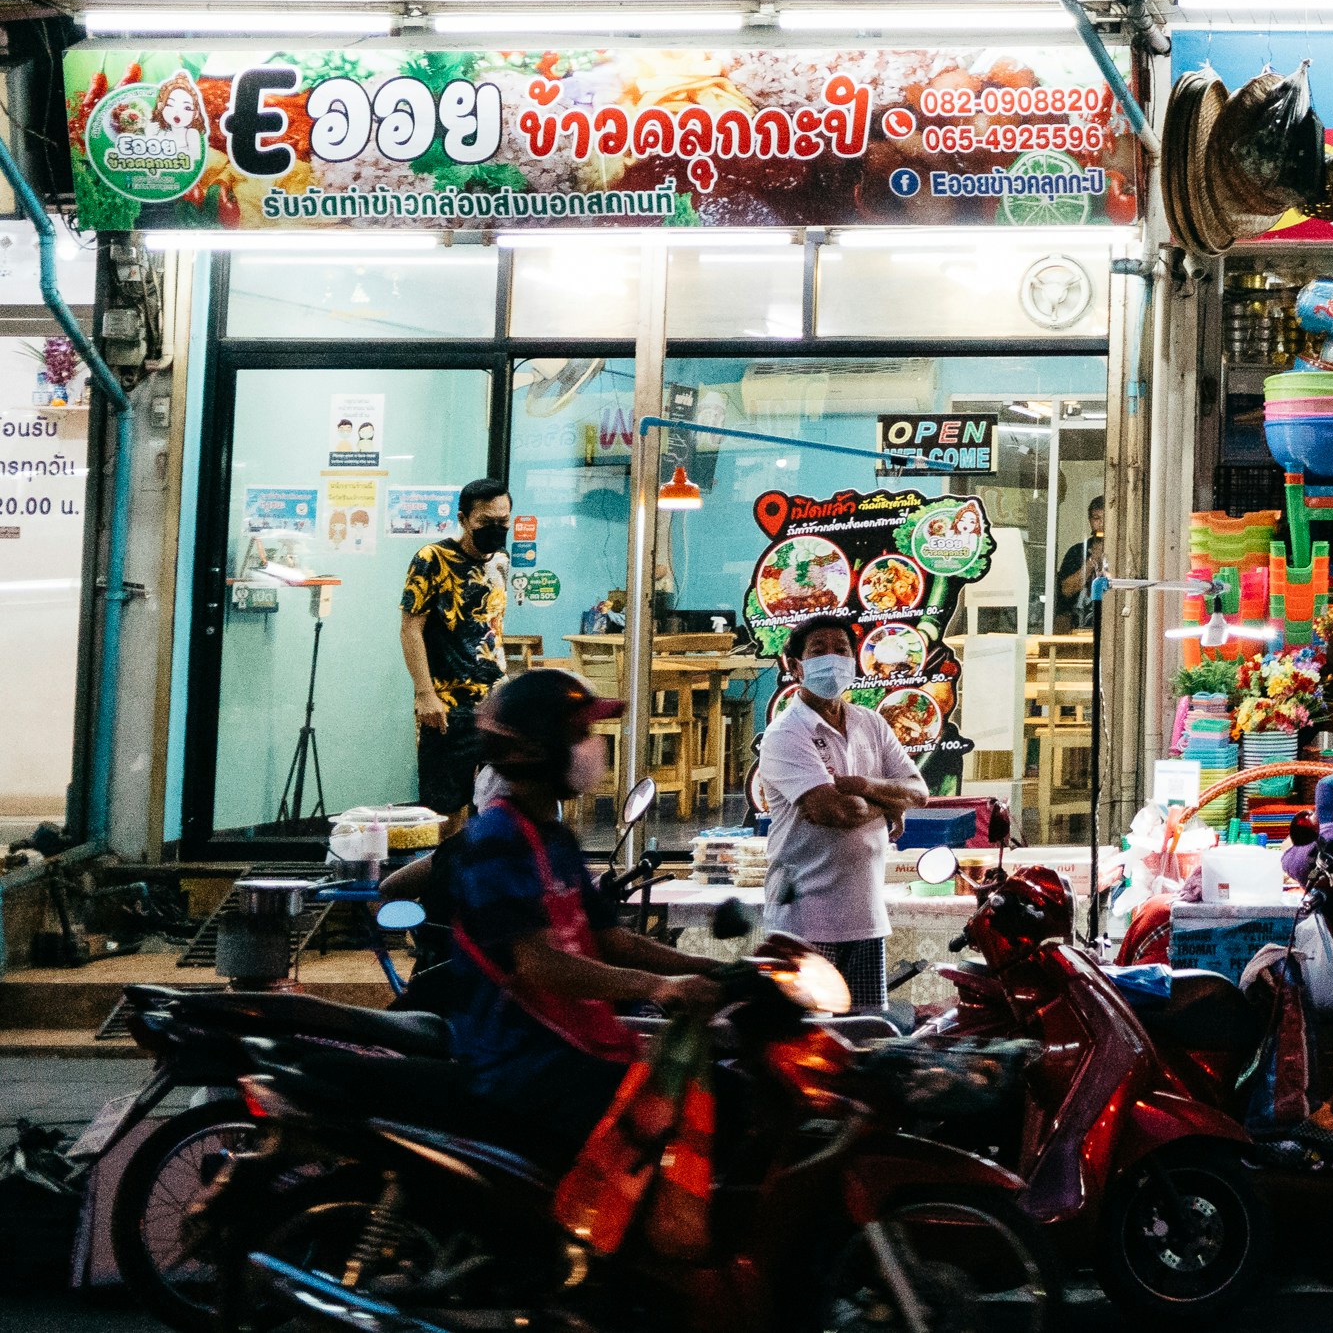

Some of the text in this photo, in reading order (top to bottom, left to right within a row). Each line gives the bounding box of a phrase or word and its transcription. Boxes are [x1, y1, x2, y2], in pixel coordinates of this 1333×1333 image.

[921, 89, 1099, 115] 082-0908820
[519, 74, 873, 193] ข้าวคลุกกะปิ
[924, 125, 1102, 152] 065-4925596
[930, 168, 1105, 199] Eออยข้าวคลุกกะปิ
[263, 178, 676, 220] รับจัดทำข้าวกล่องส่งนอกสถานที่
[0, 415, 58, 437] อนรับ
[888, 420, 986, 444] OPEN
[0, 497, 51, 515] 0.00
[791, 493, 857, 520] เปิดแล้ว
[932, 673, 953, 683] 50.-
[940, 741, 969, 751] 100.-
